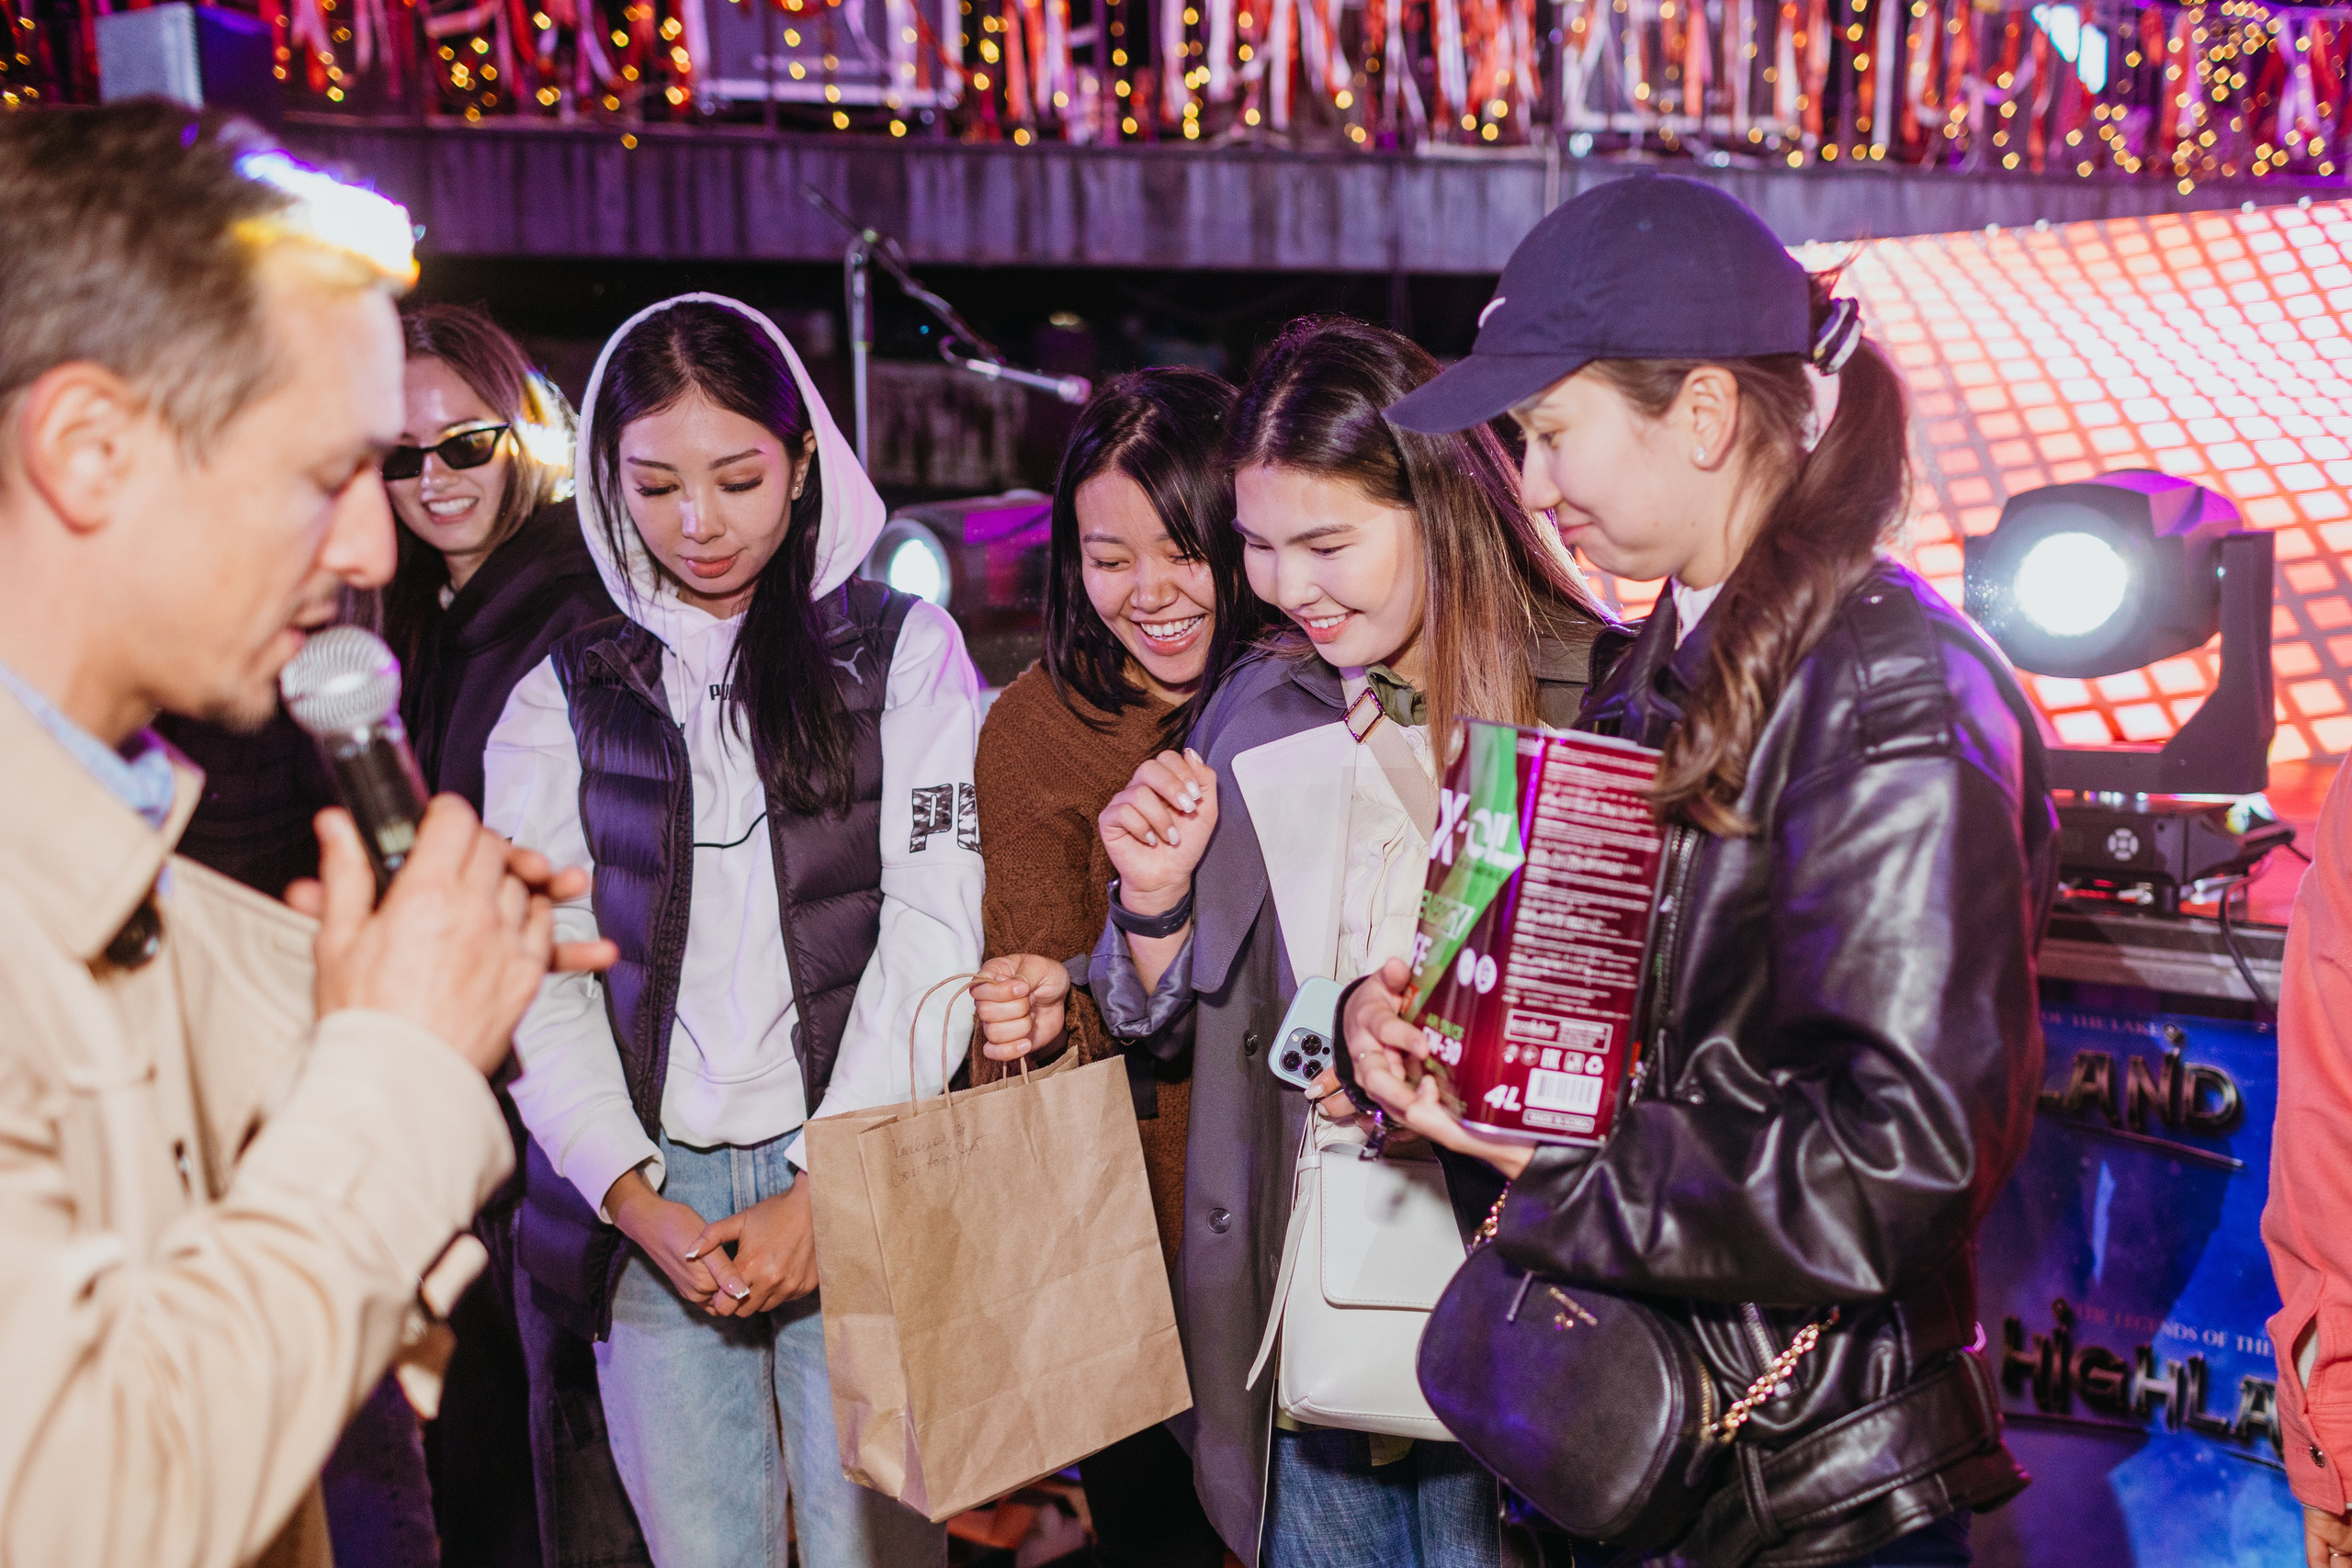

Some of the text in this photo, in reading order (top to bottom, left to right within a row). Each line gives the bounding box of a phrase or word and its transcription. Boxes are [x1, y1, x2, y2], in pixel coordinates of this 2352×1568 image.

[1483, 1084, 1521, 1111] 4L
[2114, 1311, 2198, 1342] LEGENDS
[2202, 1328, 2228, 1348] OF
